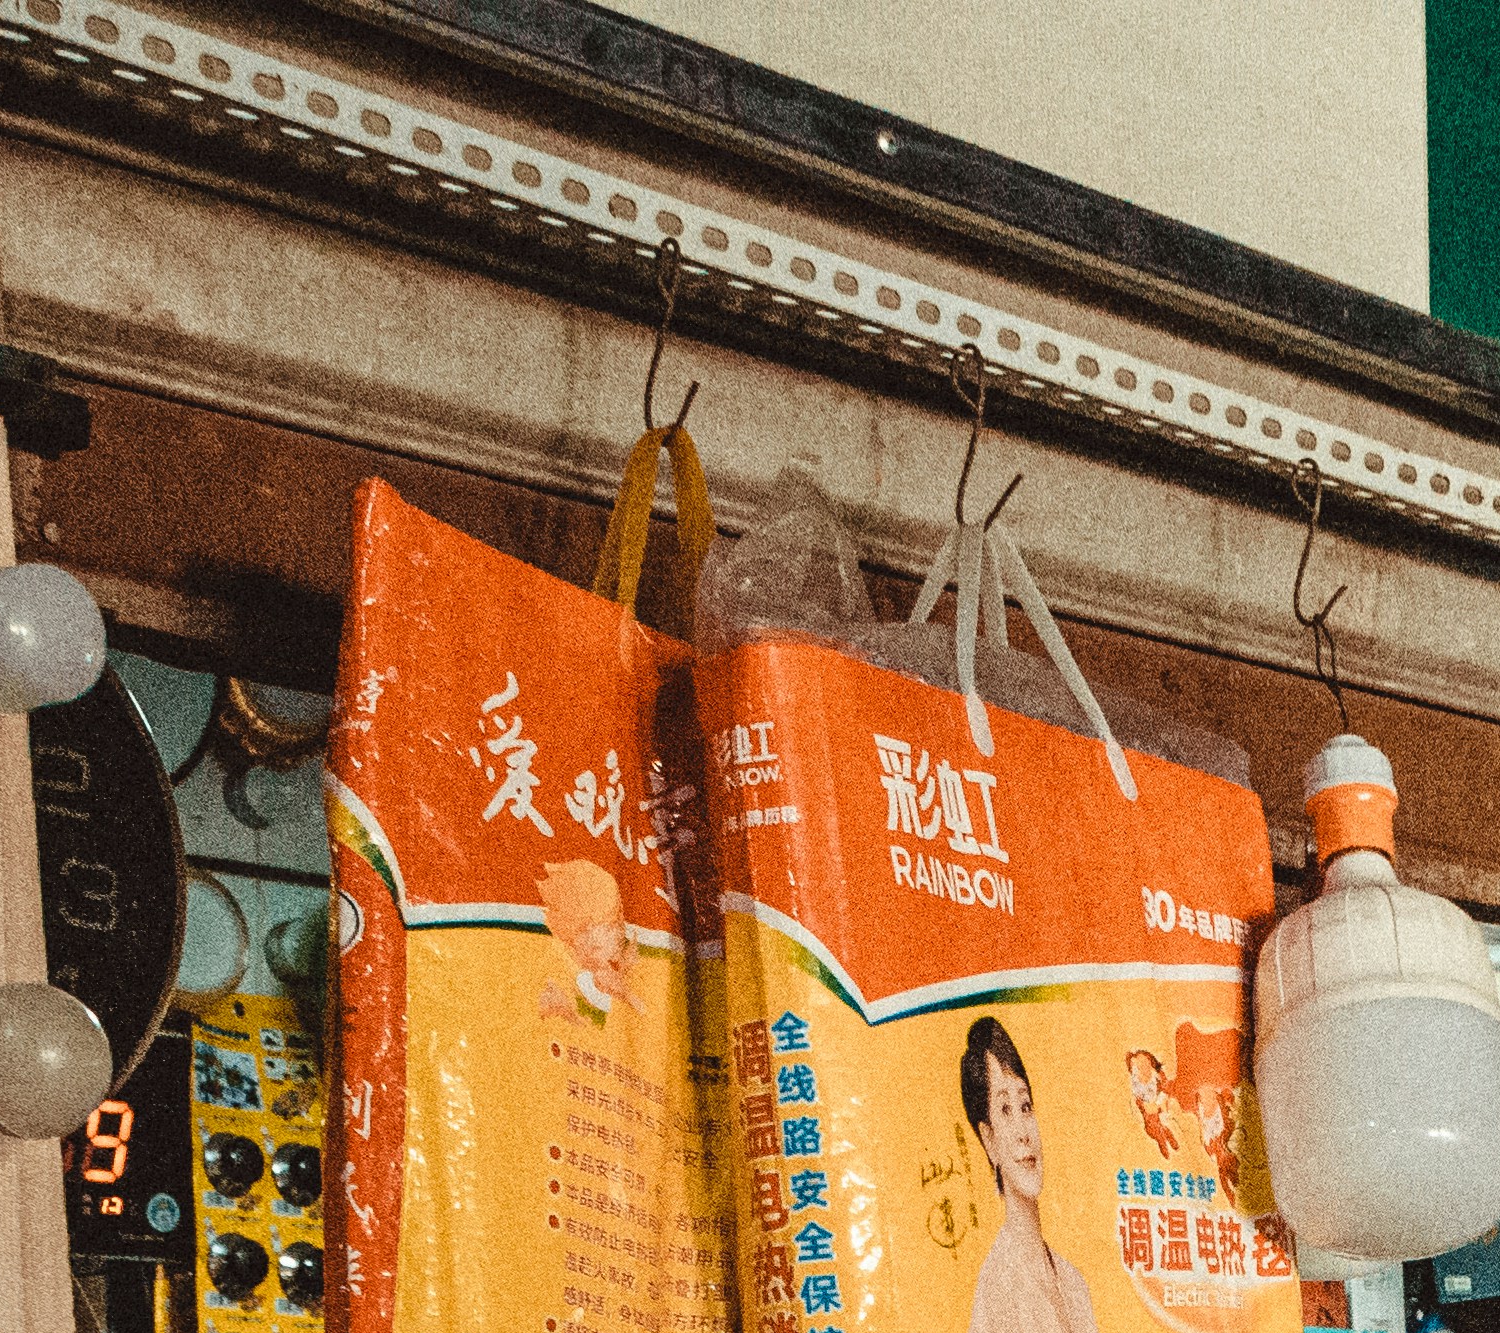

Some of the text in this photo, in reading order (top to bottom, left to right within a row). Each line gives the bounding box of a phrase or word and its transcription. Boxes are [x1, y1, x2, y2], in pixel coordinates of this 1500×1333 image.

[873, 733, 1010, 864] 彩虹
[890, 845, 1016, 918] RAINBOW
[83, 1098, 135, 1184] 9
[1119, 1207, 1298, 1278] 调温电热毯
